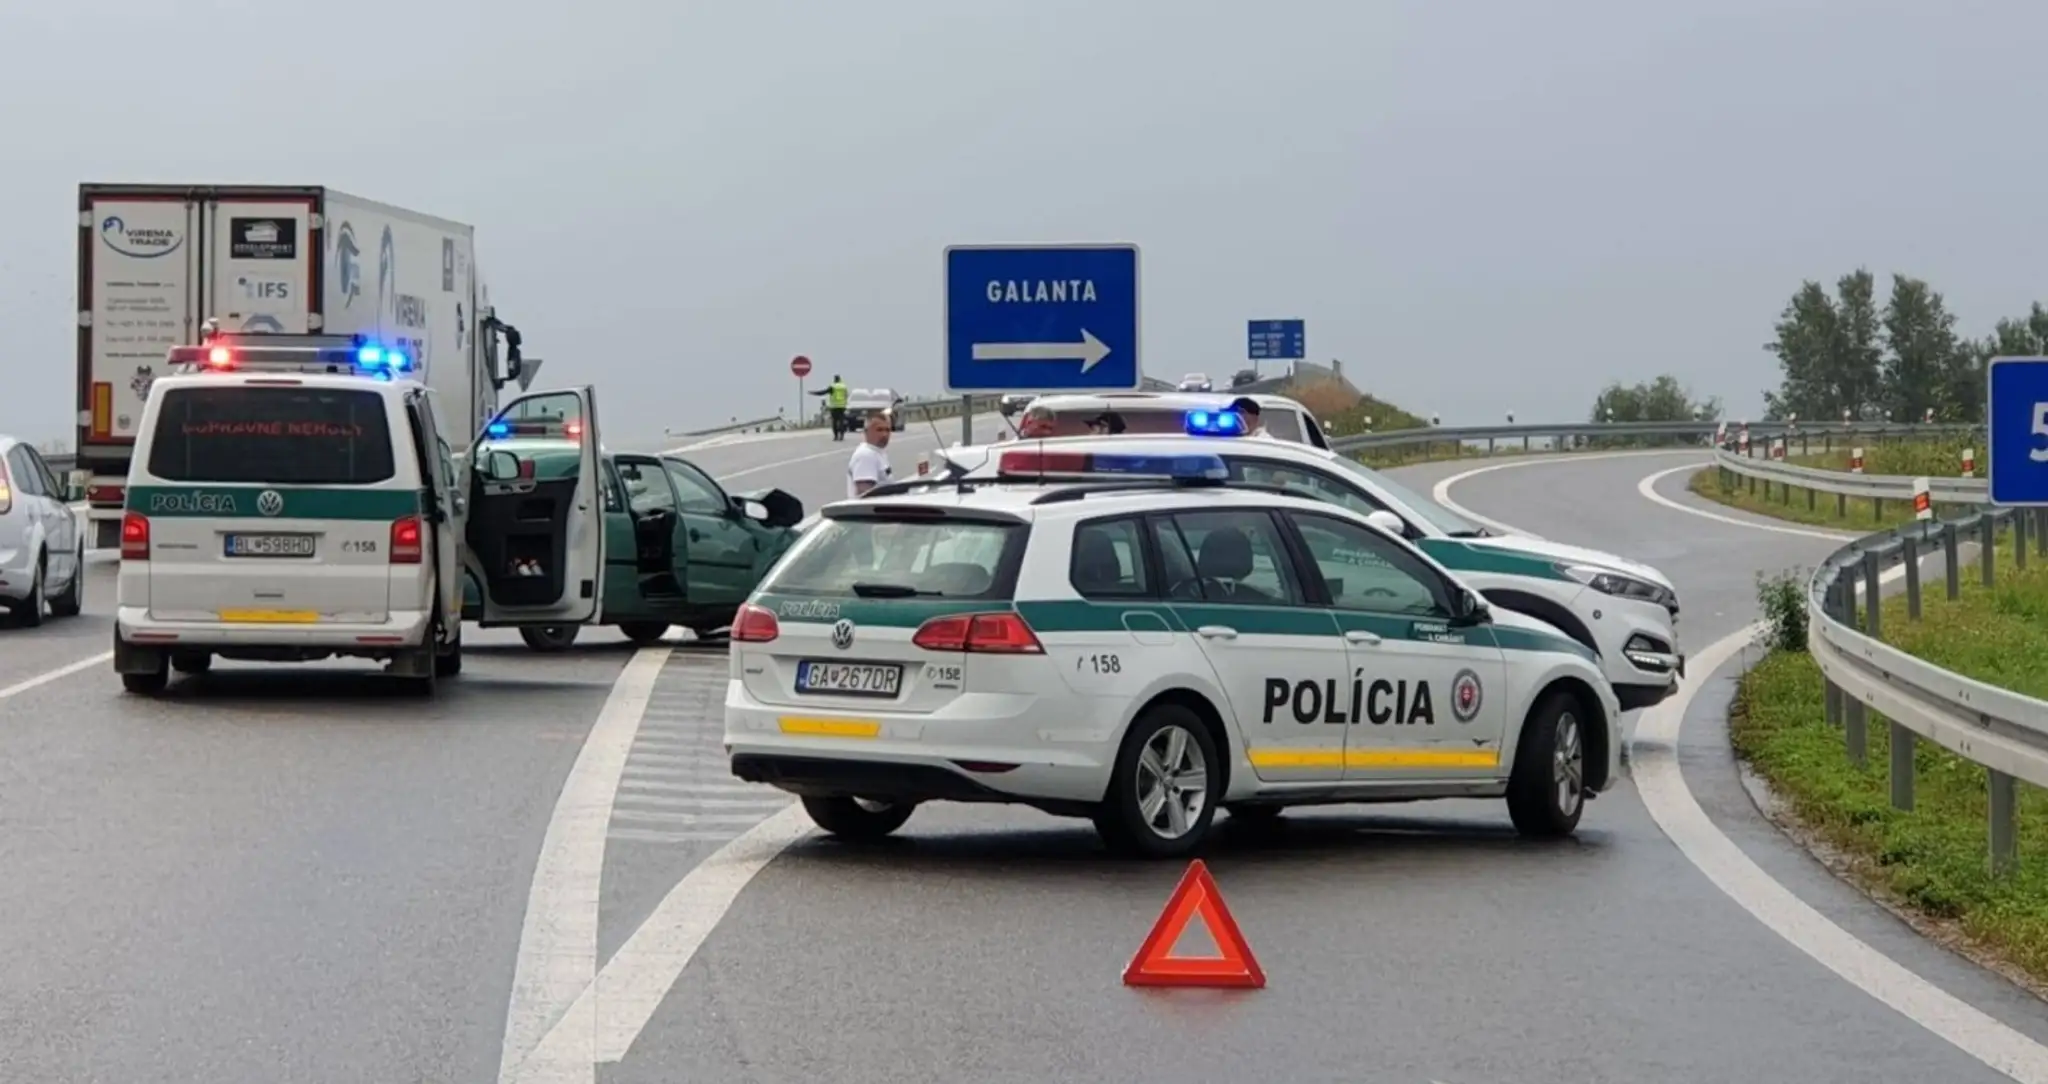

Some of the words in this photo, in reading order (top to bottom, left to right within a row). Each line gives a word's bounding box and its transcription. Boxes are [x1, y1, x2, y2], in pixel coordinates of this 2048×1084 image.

[258, 281, 288, 299] IFS
[986, 280, 1097, 302] GALANTA
[151, 490, 237, 512] POLÍCIA
[1091, 654, 1122, 674] 158
[1263, 667, 1434, 725] POLÍCIA
